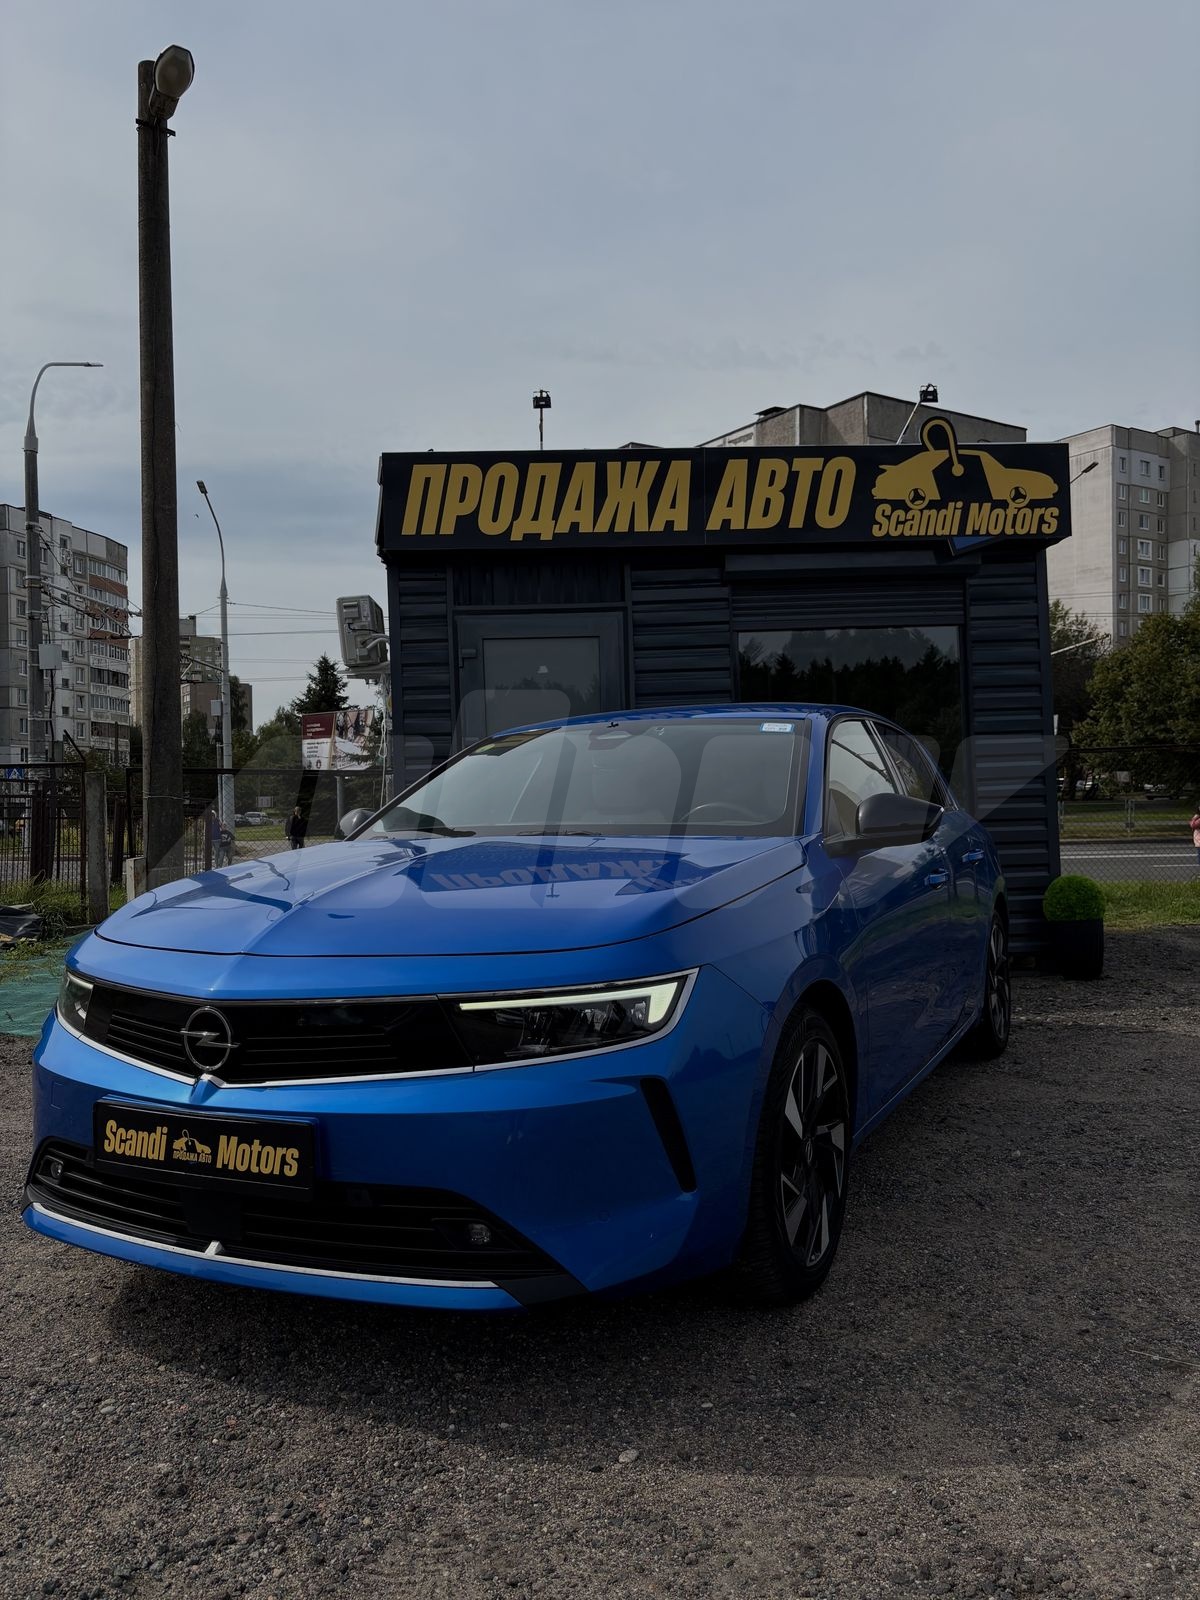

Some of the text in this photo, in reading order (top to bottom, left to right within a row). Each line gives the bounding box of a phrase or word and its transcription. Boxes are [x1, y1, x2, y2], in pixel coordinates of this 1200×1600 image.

[401, 457, 857, 541] ПРОДАЖА АВТО
[871, 501, 1060, 537] Scandi Motors
[103, 1119, 300, 1178] Scandi Motors
